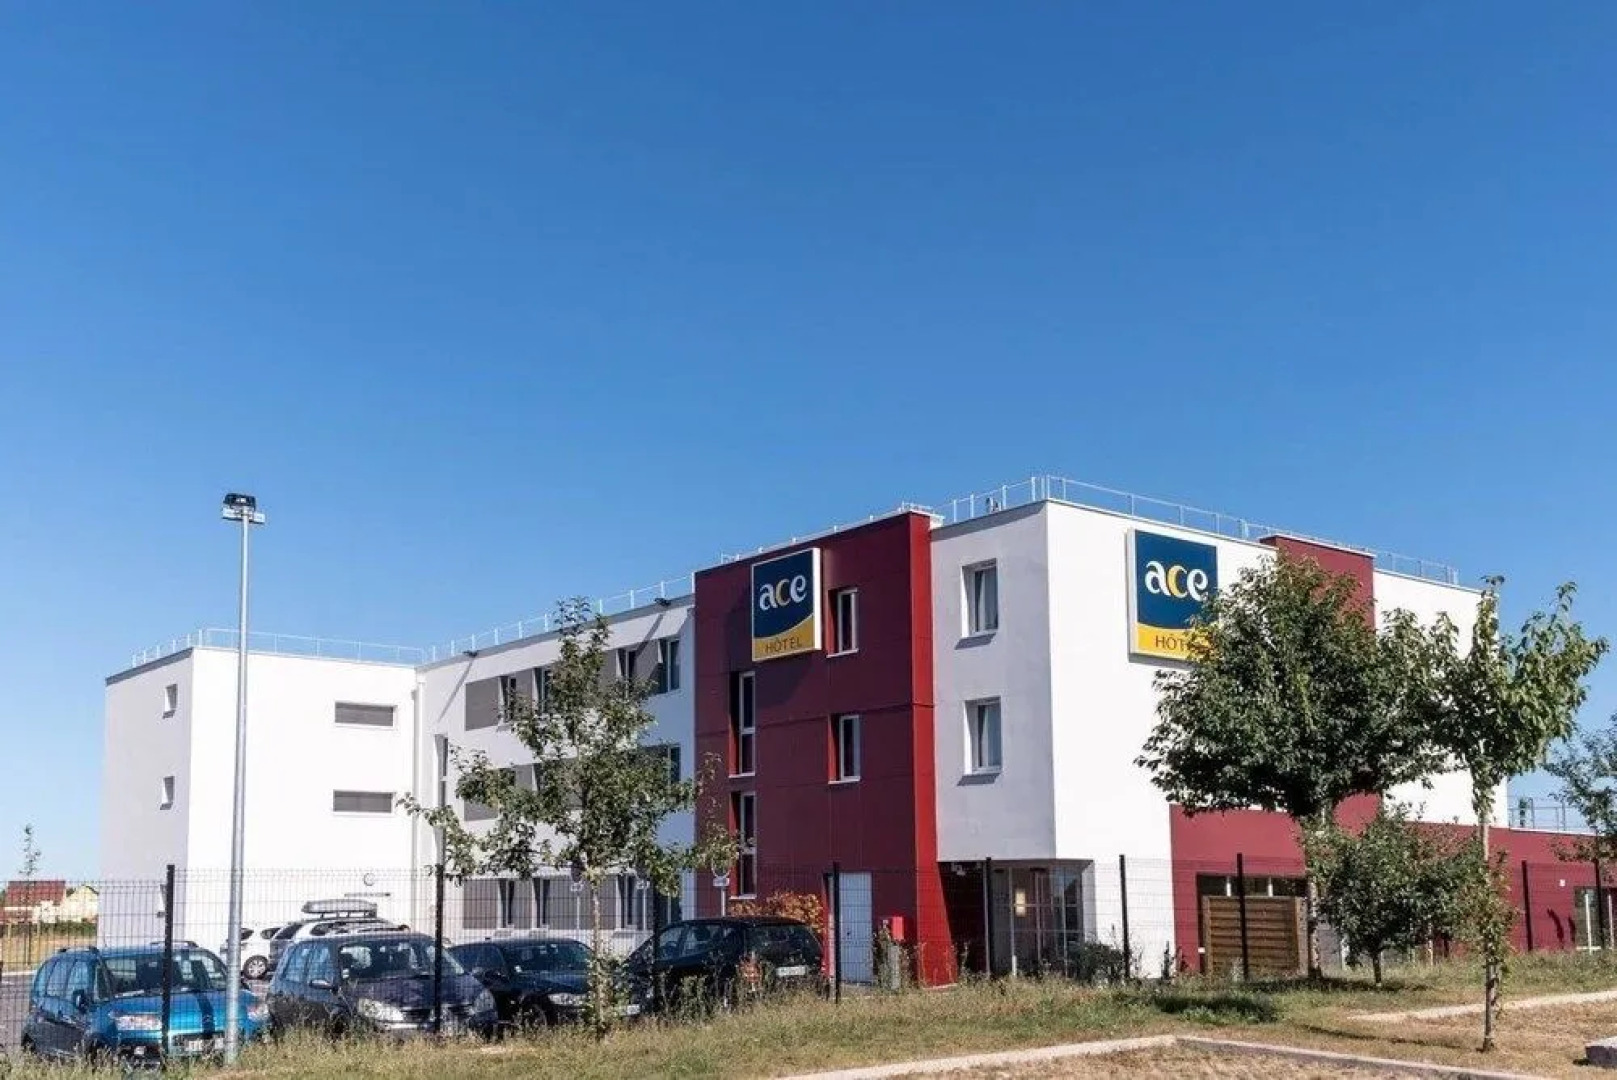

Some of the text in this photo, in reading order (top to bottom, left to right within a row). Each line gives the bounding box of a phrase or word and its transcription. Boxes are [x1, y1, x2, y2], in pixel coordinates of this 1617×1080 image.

[759, 574, 807, 611] ace
[1144, 560, 1209, 602] ace
[765, 636, 802, 653] HÔTEL
[1155, 633, 1189, 651] HÔT
